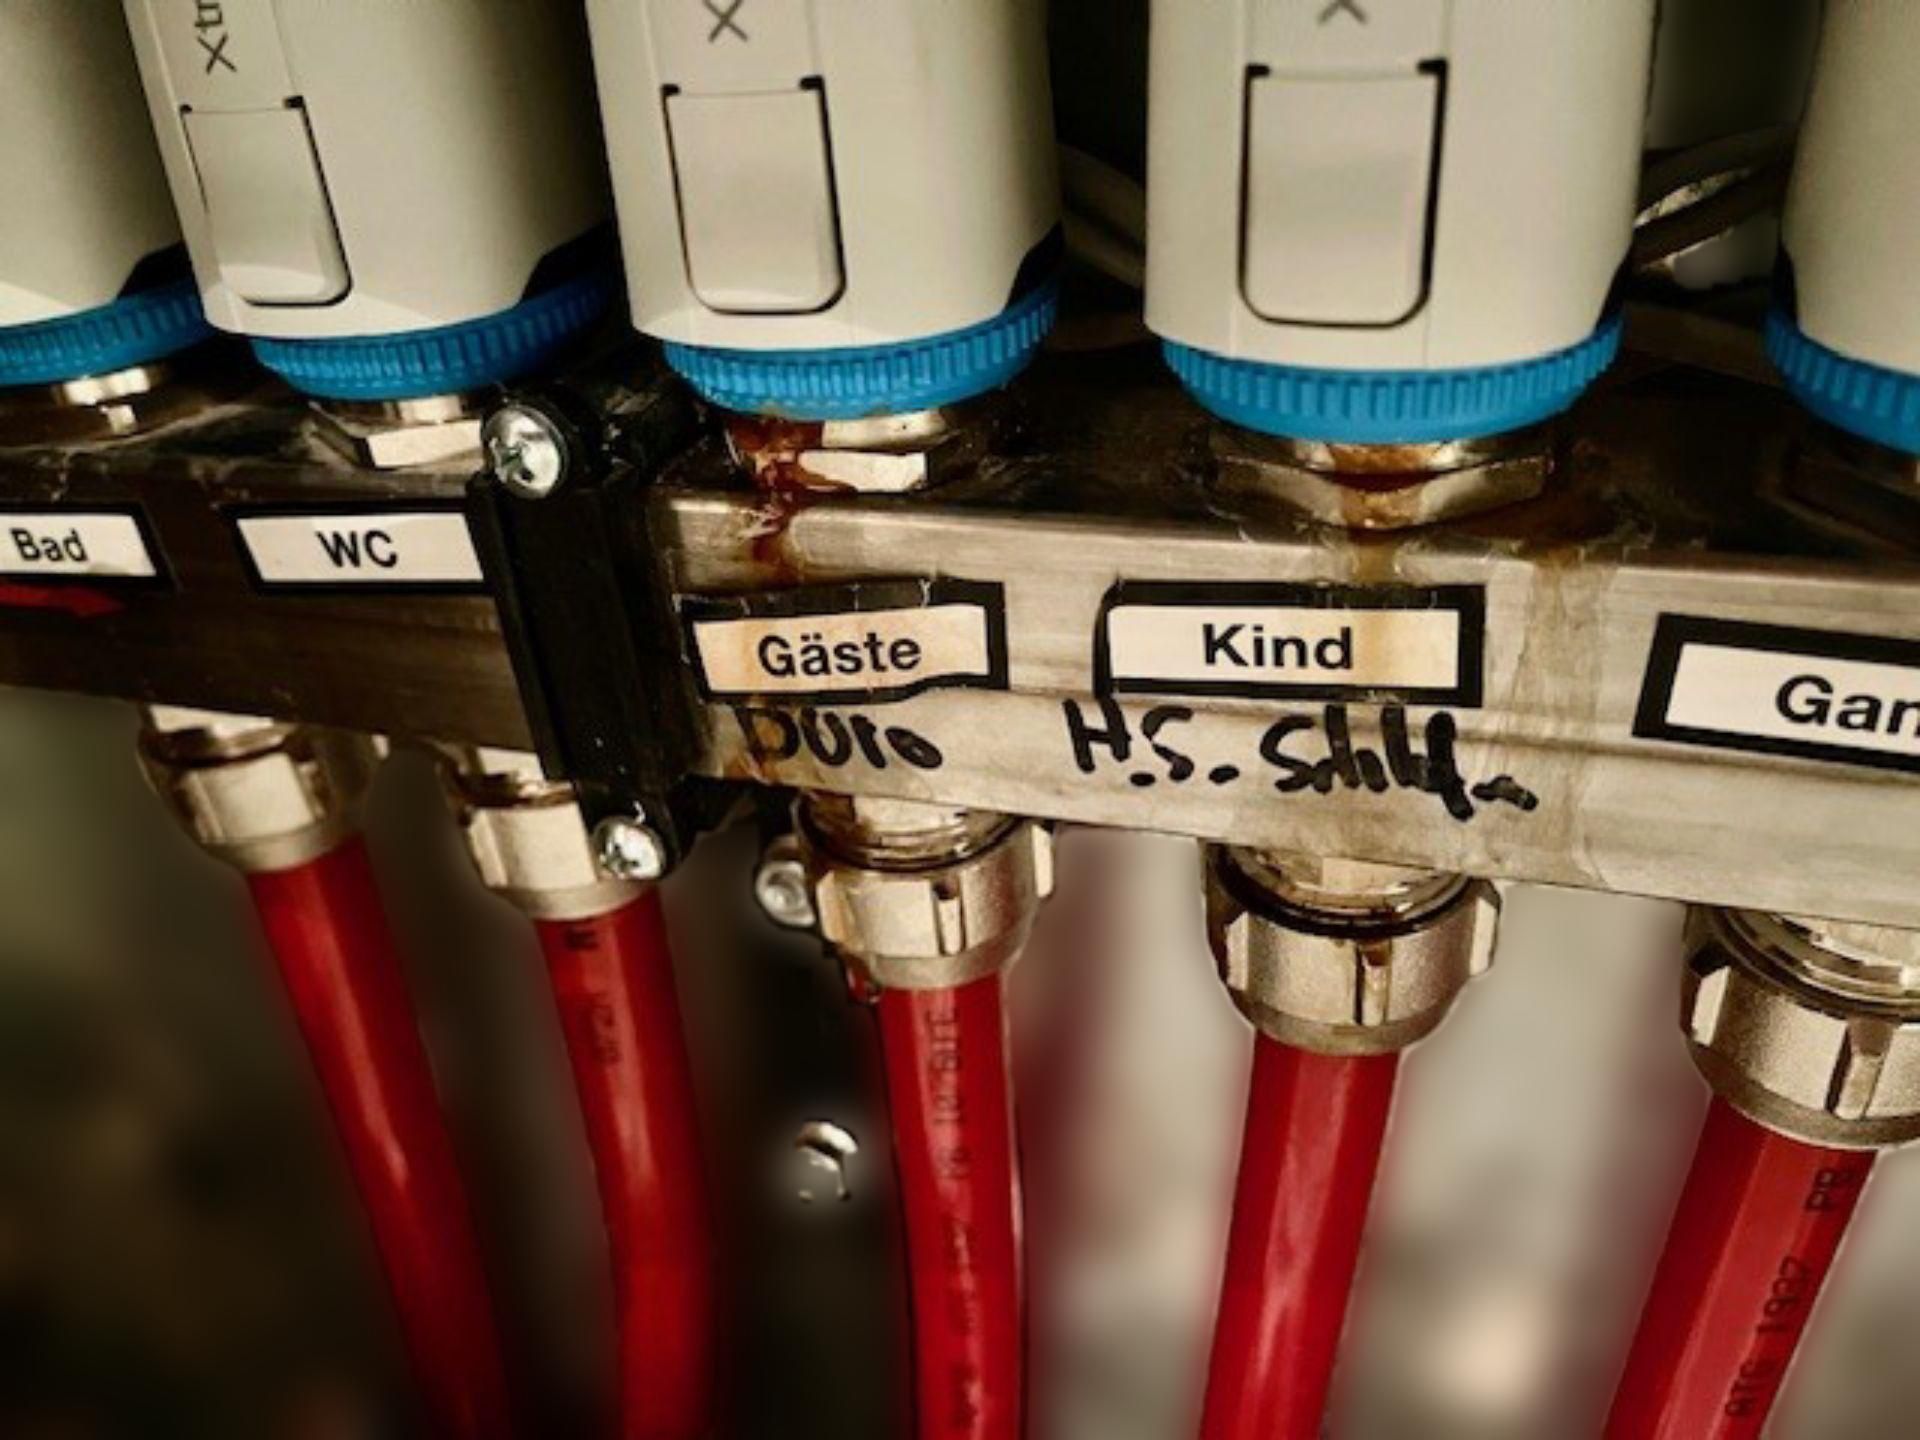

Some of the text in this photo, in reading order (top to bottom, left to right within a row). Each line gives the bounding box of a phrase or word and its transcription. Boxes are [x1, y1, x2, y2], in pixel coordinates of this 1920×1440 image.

[10, 528, 88, 562] Bad
[318, 530, 399, 569] WC
[758, 631, 922, 678] Gäste
[1202, 624, 1354, 671] Kind
